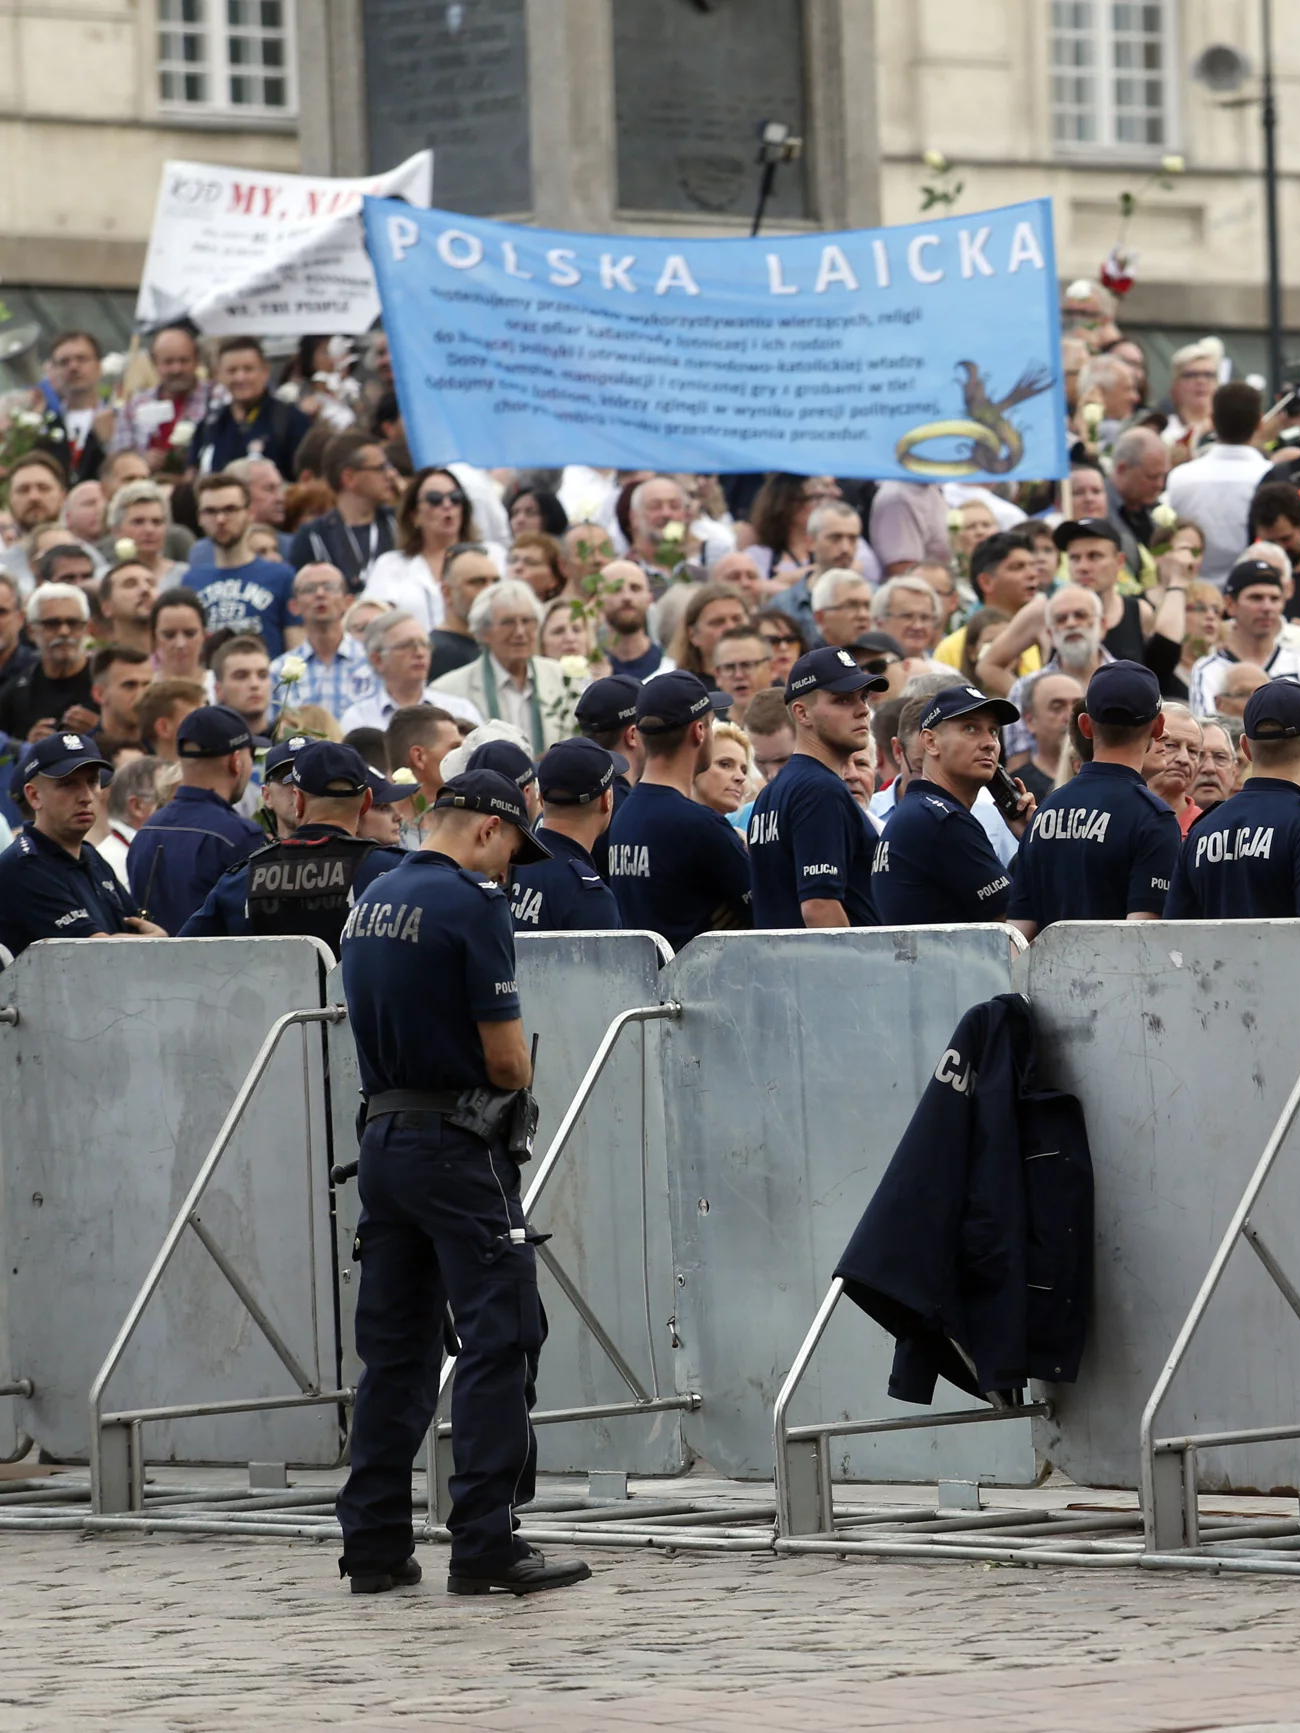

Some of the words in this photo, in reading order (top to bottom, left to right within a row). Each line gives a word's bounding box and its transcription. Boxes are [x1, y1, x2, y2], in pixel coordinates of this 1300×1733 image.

[386, 216, 701, 296] POLSKA
[766, 221, 1046, 295] LAICKA
[791, 674, 817, 691] POLICJA
[921, 707, 941, 729] POLICJA
[490, 797, 521, 817] POLICJA
[1030, 807, 1112, 844] POLICJA
[1195, 826, 1274, 868] POLICJA
[251, 861, 345, 892] POLICJA
[803, 864, 838, 877] POLICJA
[977, 875, 1010, 901] POLICJA
